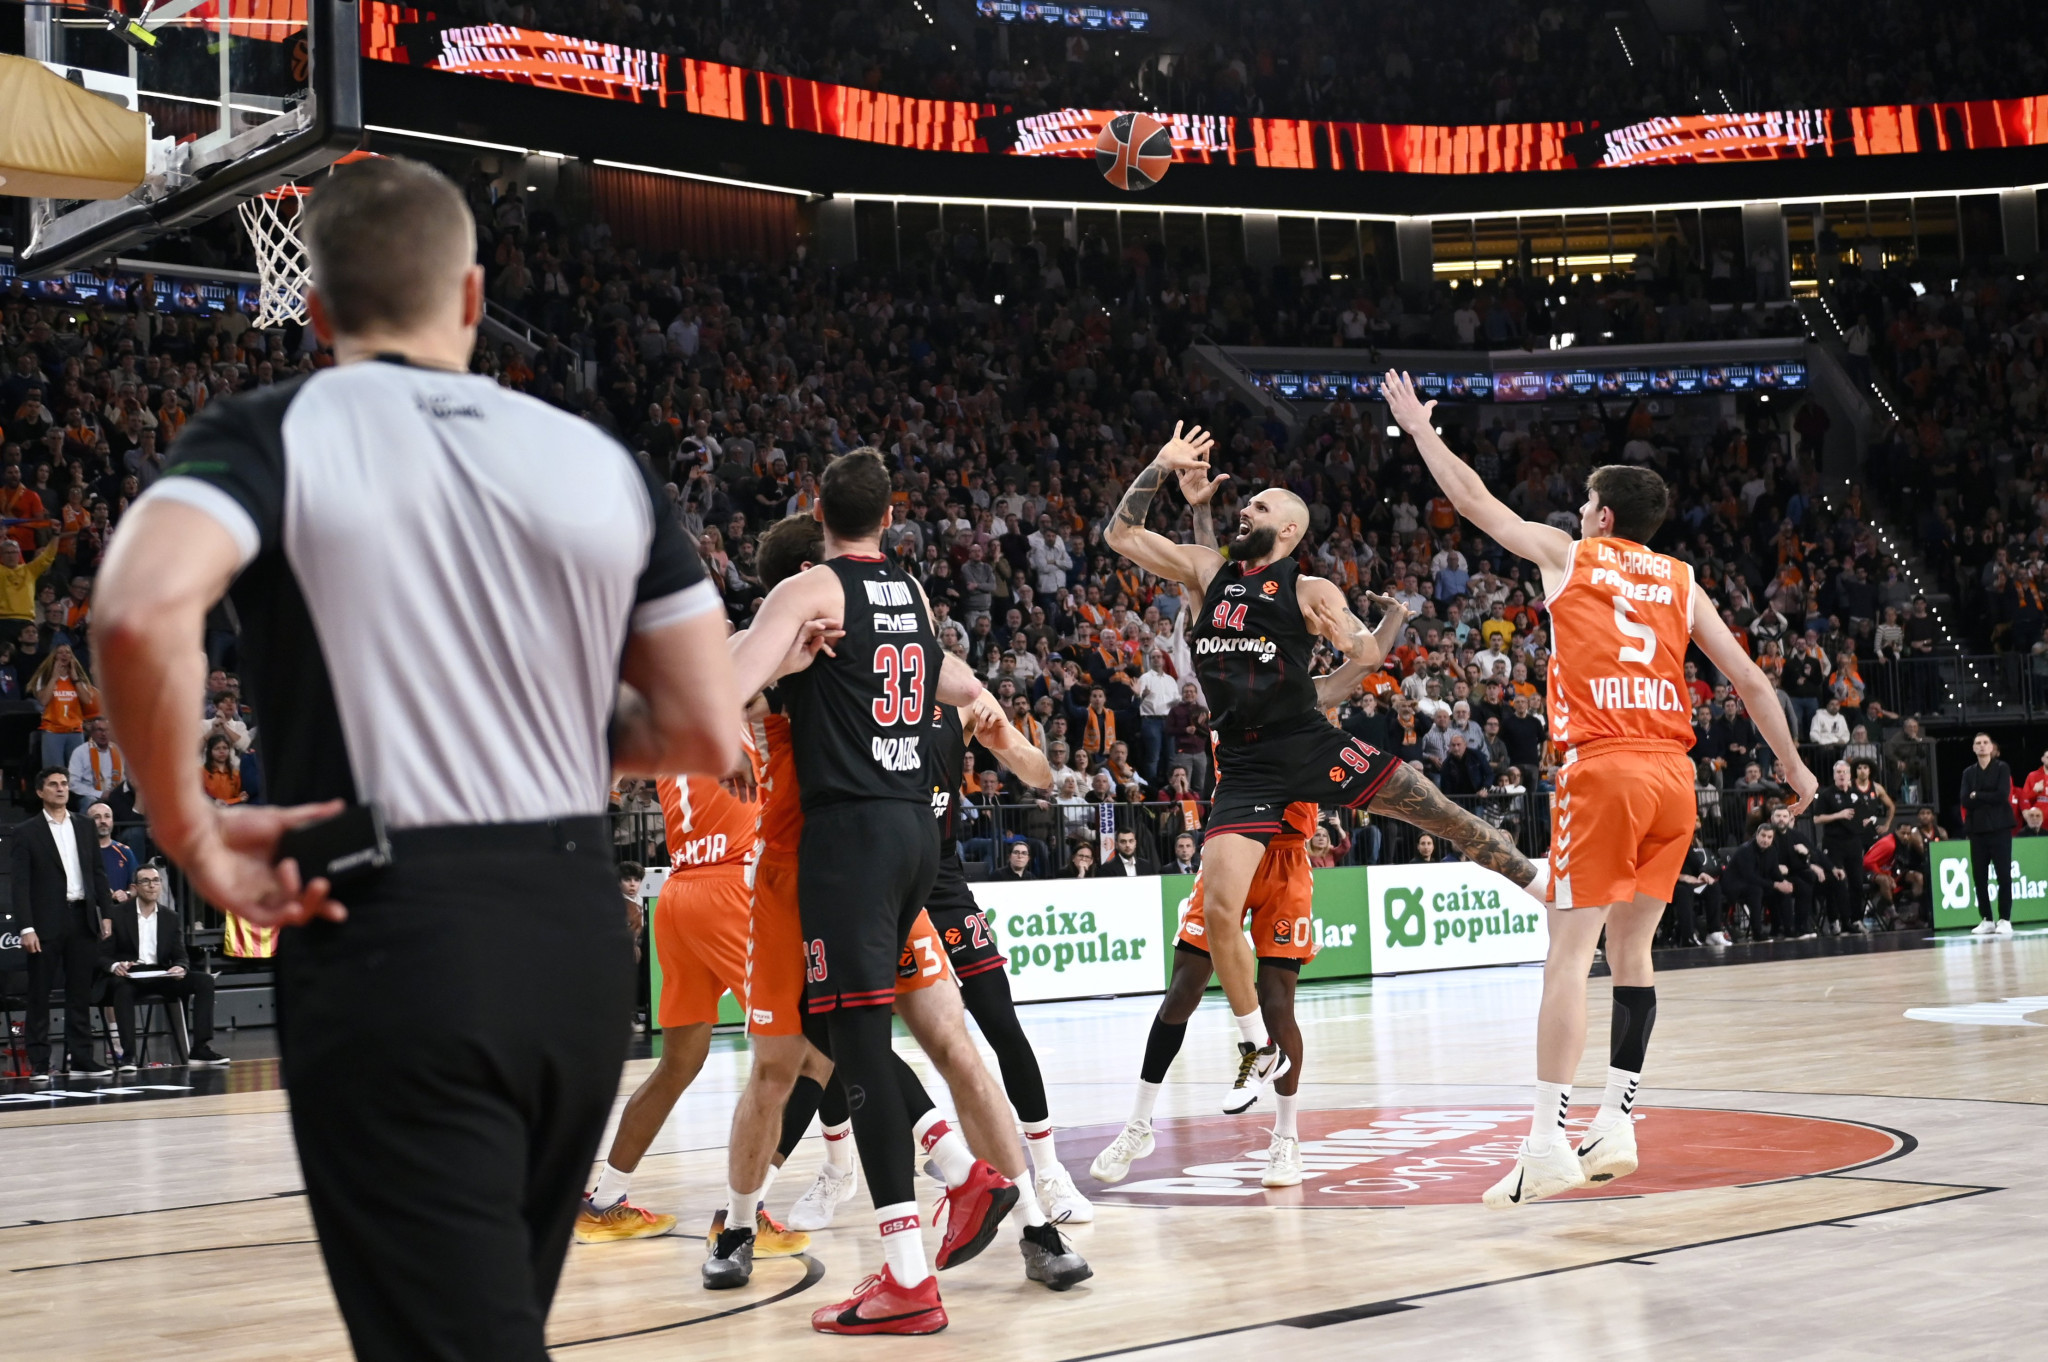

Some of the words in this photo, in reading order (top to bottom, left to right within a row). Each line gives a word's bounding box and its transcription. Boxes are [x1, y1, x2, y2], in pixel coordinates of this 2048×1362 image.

[1591, 567, 1673, 605] PAMESA
[873, 613, 918, 633] FMS
[1212, 600, 1248, 631] 94
[1612, 595, 1657, 665] 5
[872, 643, 925, 726] 33
[871, 736, 921, 771] PIRAEUS
[1340, 736, 1380, 774] 94
[676, 774, 694, 834] 1
[1432, 884, 1501, 913] caixa
[1008, 905, 1097, 938] caixa
[1293, 917, 1310, 948] 0
[1433, 908, 1539, 946] popular
[913, 936, 942, 978] 3
[1009, 932, 1146, 976] popular
[882, 1218, 918, 1235] GSA
